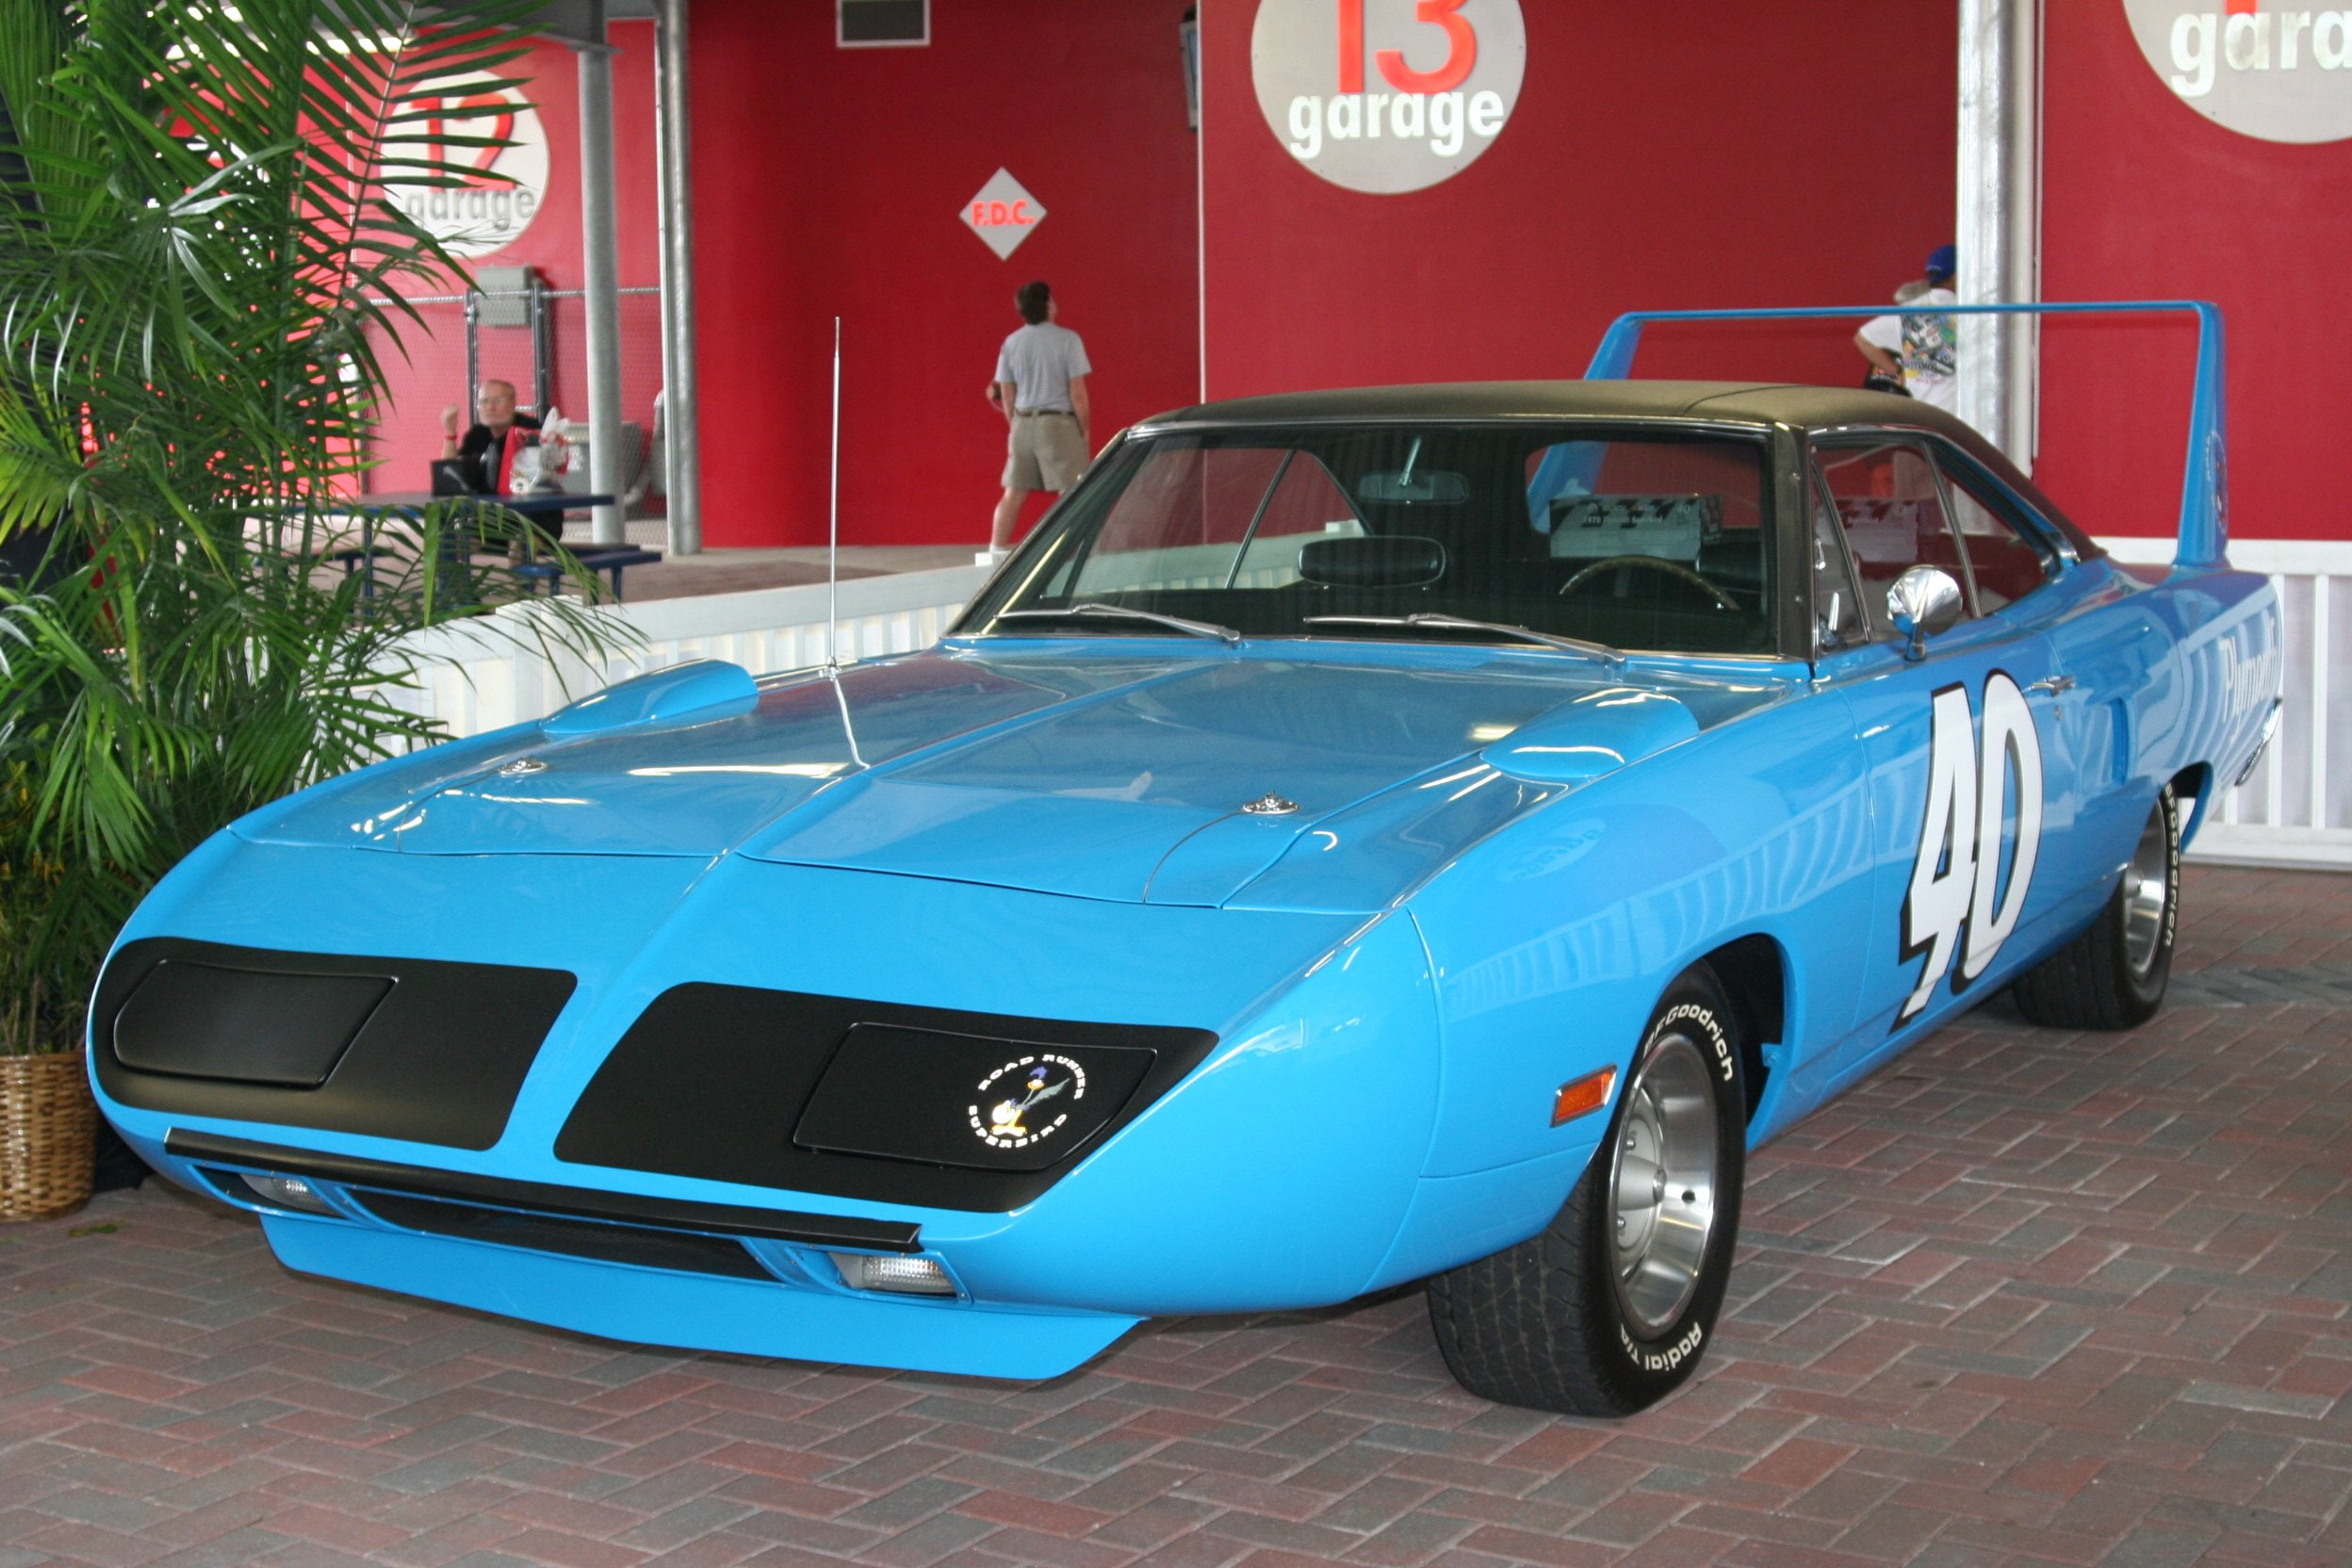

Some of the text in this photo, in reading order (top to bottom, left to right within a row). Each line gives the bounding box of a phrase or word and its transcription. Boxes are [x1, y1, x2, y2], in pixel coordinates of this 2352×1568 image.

[1338, 0, 1477, 94] 13
[410, 94, 514, 193] 12
[1288, 90, 1505, 158] garage
[406, 188, 535, 231] garage
[972, 200, 1036, 226] F.D.C.
[1889, 668, 2044, 1033] 40
[978, 1054, 1086, 1100] ROAD RUNNER
[969, 1104, 1067, 1149] SUPERBIRD
[1644, 1321, 1703, 1372] Radial
